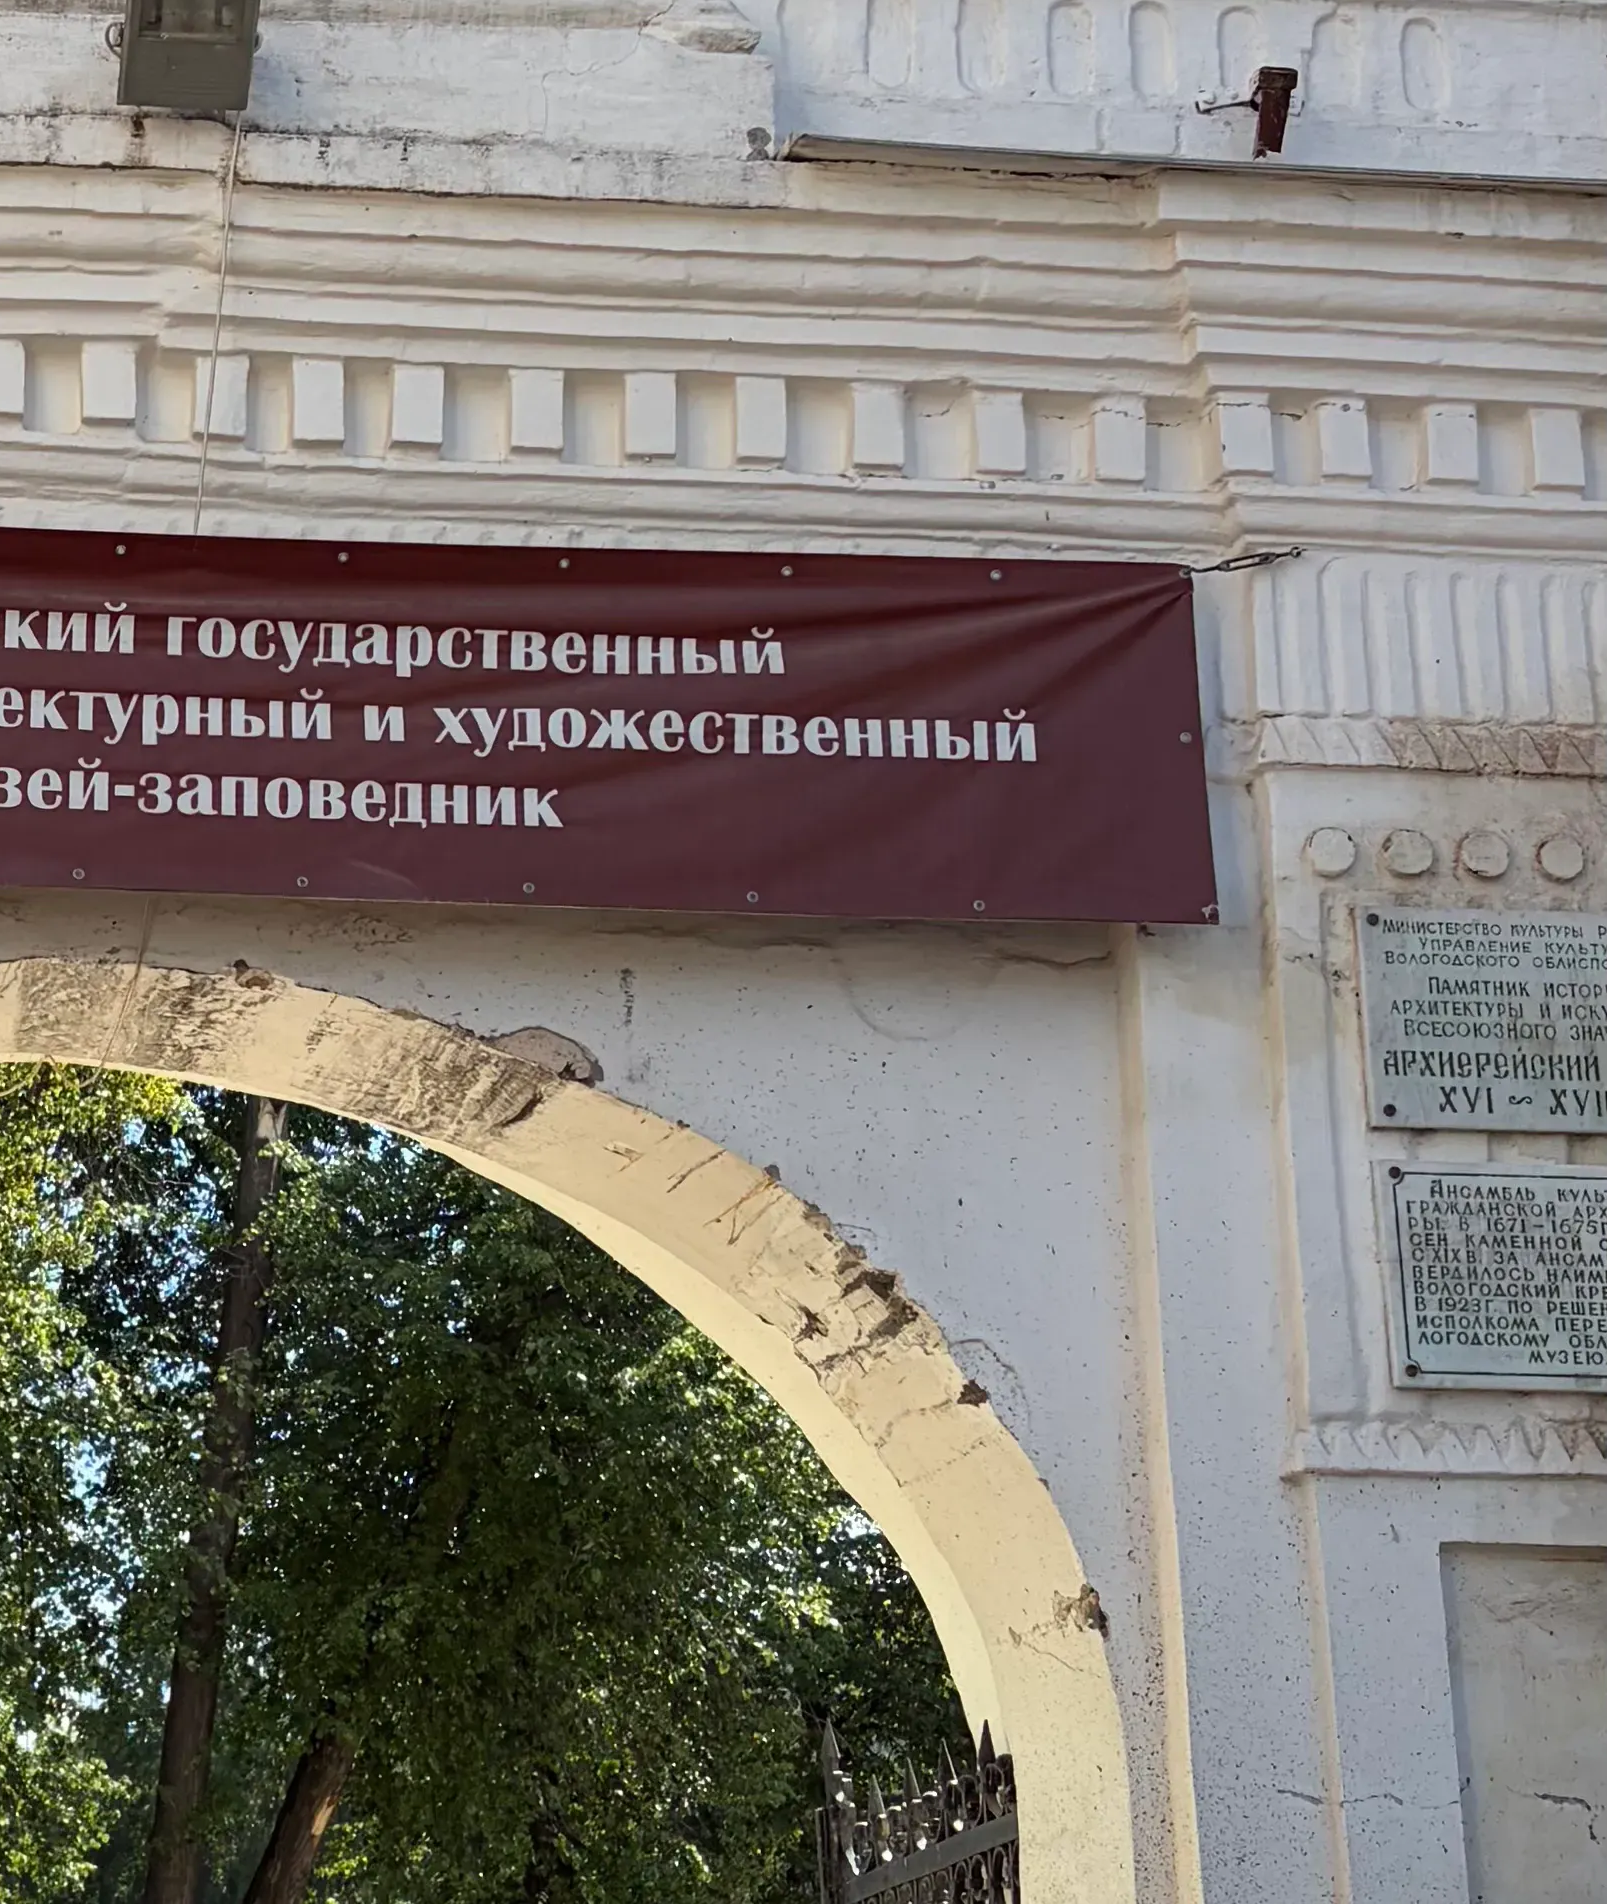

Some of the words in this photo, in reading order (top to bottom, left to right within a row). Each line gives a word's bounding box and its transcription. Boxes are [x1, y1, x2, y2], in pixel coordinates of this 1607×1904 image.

[166, 614, 785, 678] государственный
[363, 704, 405, 743] и
[435, 704, 1037, 763] художественный
[1382, 918, 1502, 937] МИНИСТЕРСТВО
[1510, 923, 1583, 939] КУЛЬТУРЫ
[1418, 936, 1532, 954] УПРАВЛЕНИЕ
[1384, 951, 1520, 968] ВОЛОГОДСКОГО
[1428, 976, 1531, 998] ПАМЯТНИК
[1543, 982, 1607, 999] ИСТОР
[1390, 999, 1524, 1019] АРХИТЕКТУРЫ
[1539, 1003, 1551, 1019] И
[1404, 1019, 1557, 1041] ВСЕСОЮЗНОГО
[1430, 1179, 1536, 1201] АНСАМБЛЬ
[1406, 1200, 1556, 1217] ГРАЖДАНСКОЙ
[1459, 1216, 1470, 1232] В
[1409, 1232, 1448, 1247] СЕН
[1464, 1233, 1582, 1252] КАМЕННОЙ
[1412, 1247, 1425, 1263] С
[1494, 1250, 1519, 1266] ЗА
[1412, 1265, 1535, 1283] ВЕРДИЛОСЬ
[1546, 1268, 1607, 1285] НАИМ
[1413, 1280, 1561, 1300] ВОЛОГОДСКИЙ
[1415, 1295, 1427, 1312] В
[1507, 1299, 1533, 1315] ПО
[1416, 1314, 1540, 1332] ИСПОЛКОМА
[1555, 1317, 1607, 1333] ПЕРЕ
[1418, 1330, 1550, 1348] ЛОГОДСКОМУ
[1568, 1334, 1607, 1350] ОБЛ
